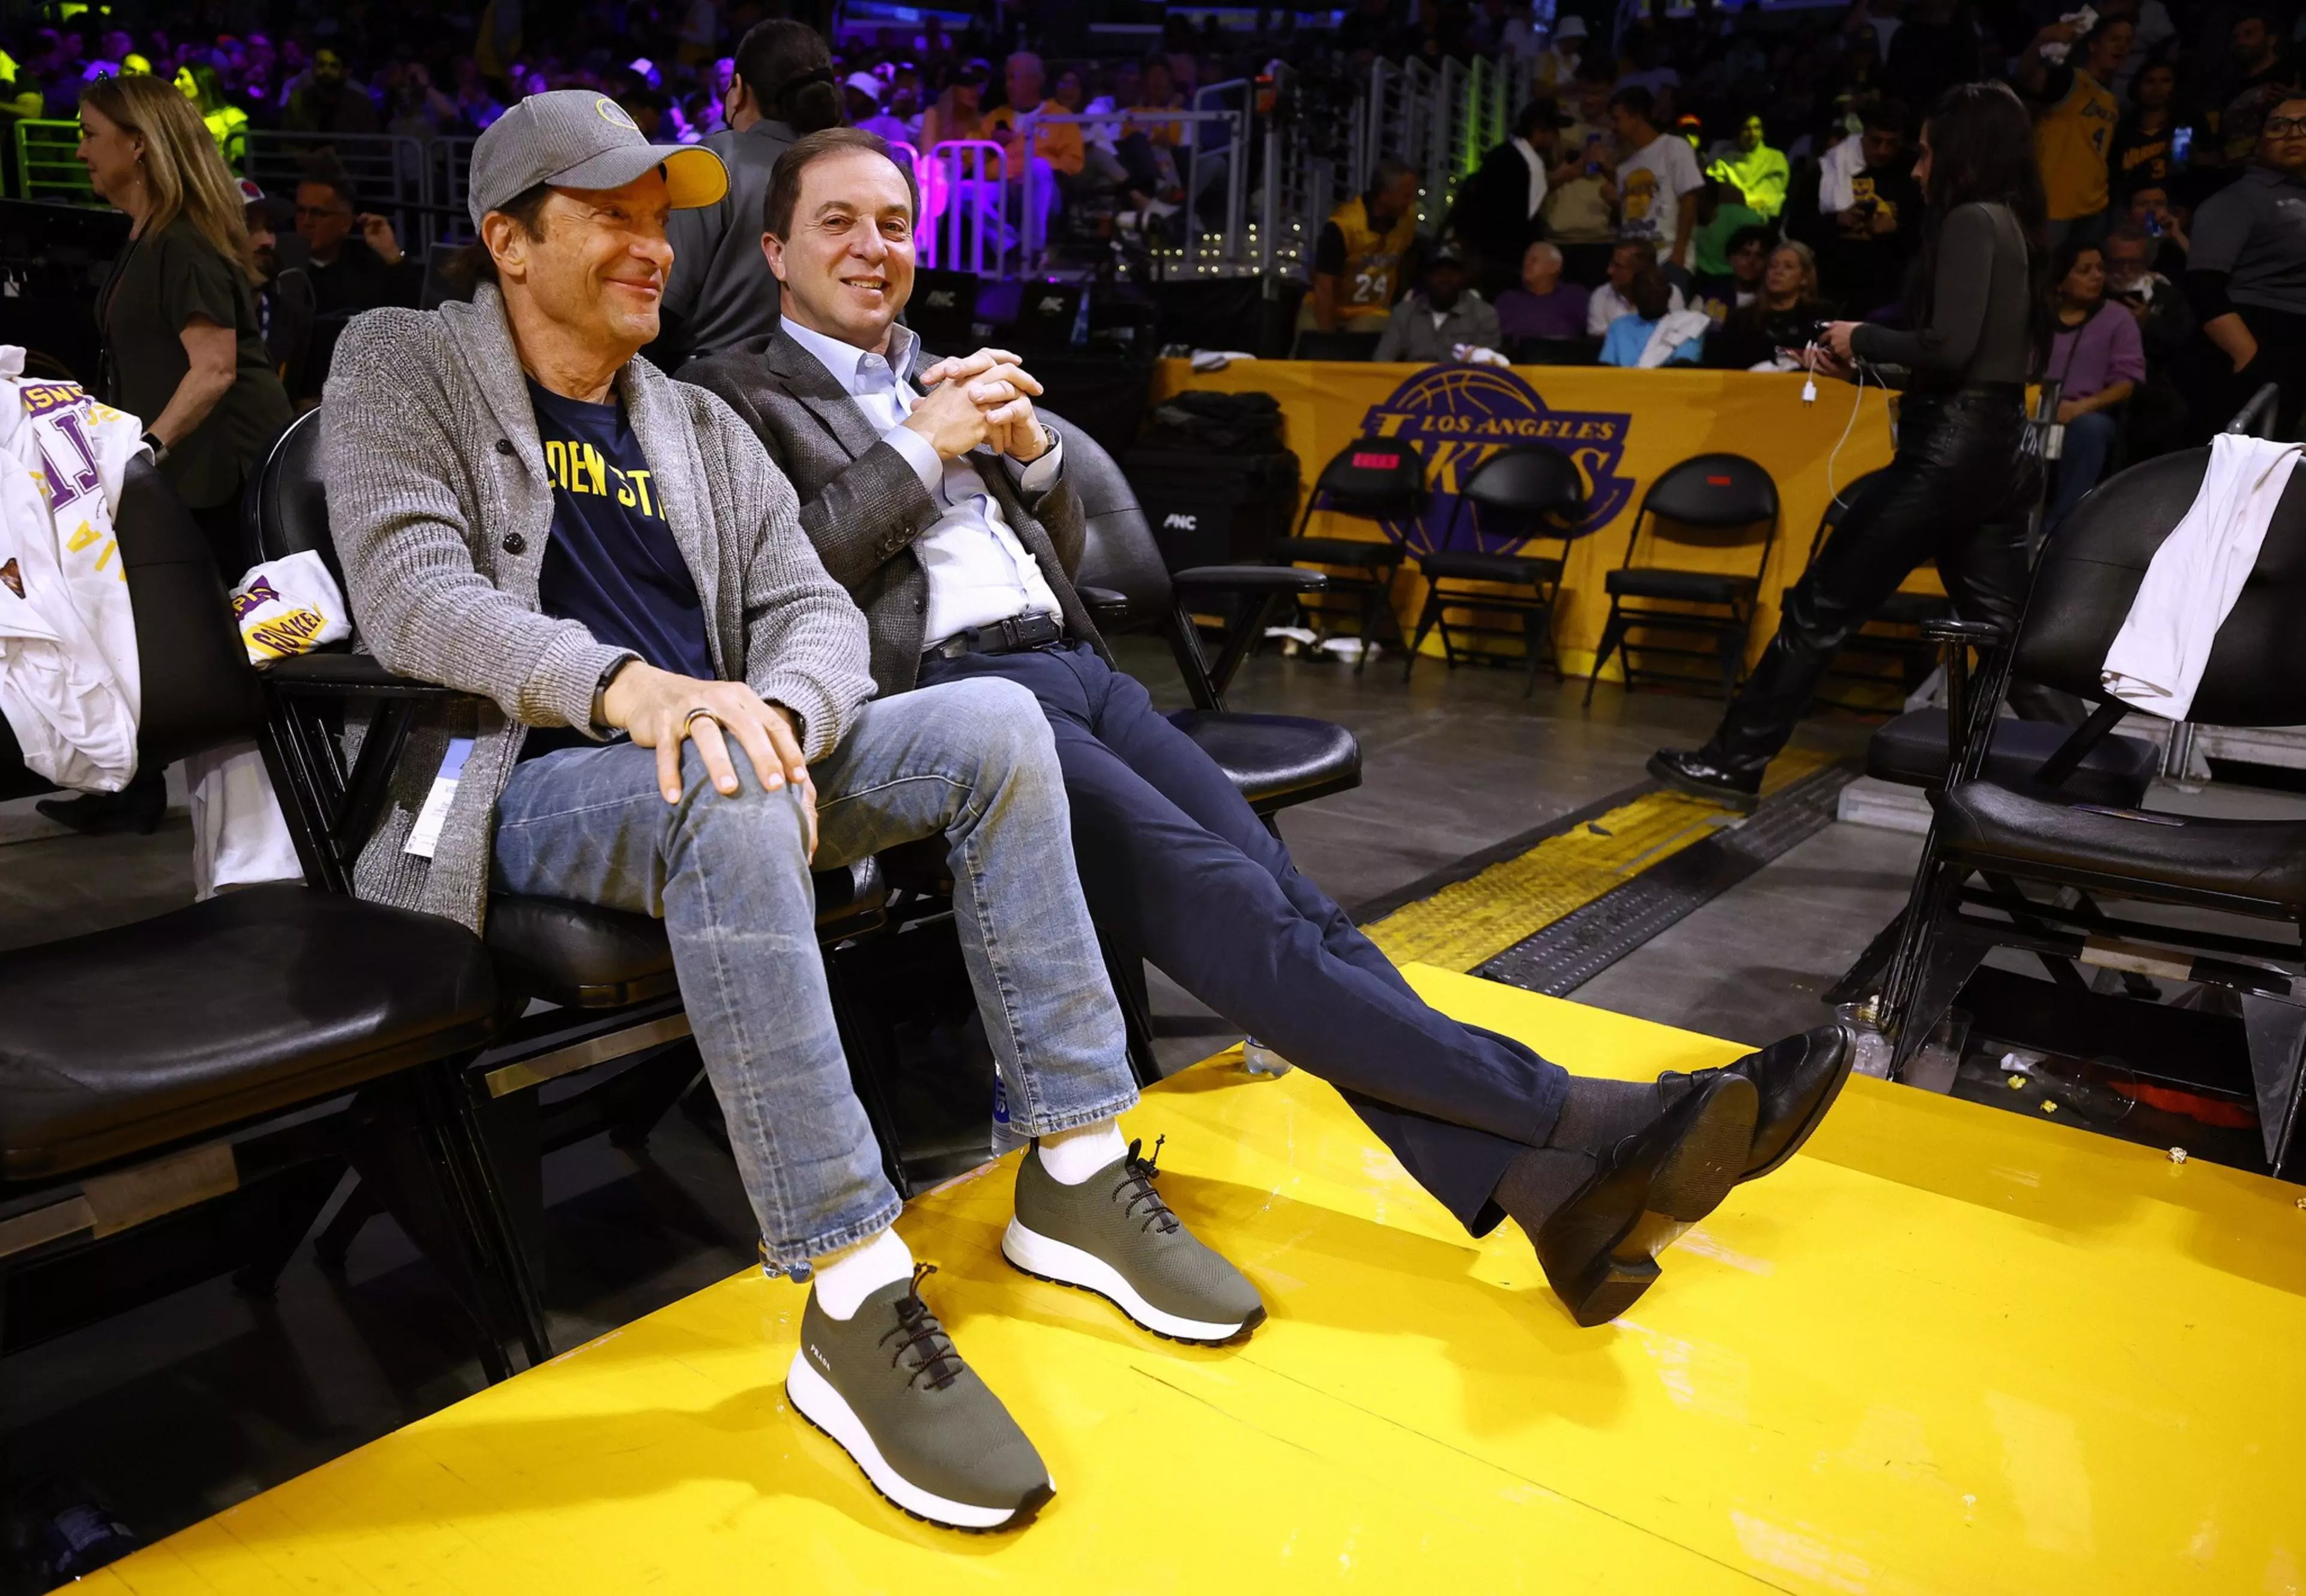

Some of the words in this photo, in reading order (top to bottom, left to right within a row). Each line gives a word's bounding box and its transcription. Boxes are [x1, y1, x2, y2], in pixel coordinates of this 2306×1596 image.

[1352, 273, 1387, 302] 24
[1420, 414, 1474, 433] LOS
[1474, 417, 1617, 441] ANGELES
[608, 465, 665, 521] ST
[811, 1343, 831, 1372] PRADA
